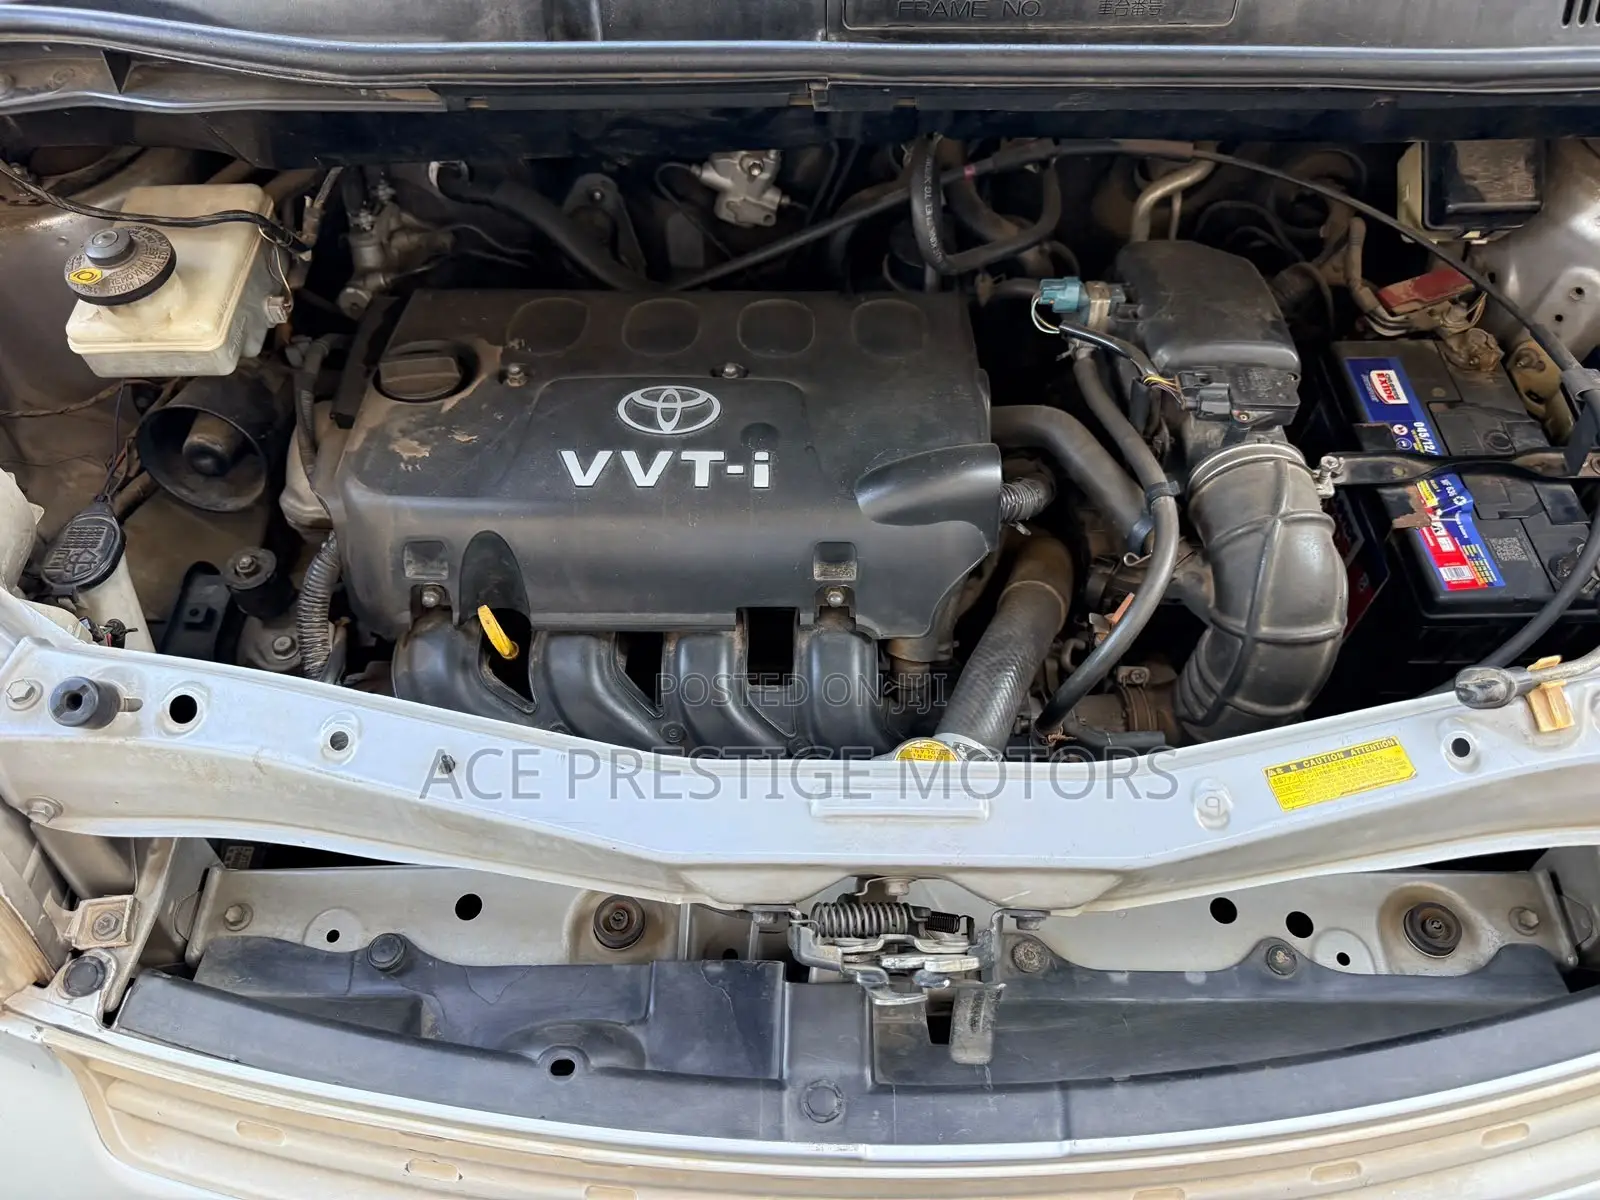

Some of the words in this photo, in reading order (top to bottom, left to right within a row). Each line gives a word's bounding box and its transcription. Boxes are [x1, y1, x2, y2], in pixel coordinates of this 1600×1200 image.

[896, 0, 991, 17] FRAME
[1376, 373, 1396, 400] EXIDE
[1413, 421, 1438, 455] 045/12/
[559, 450, 769, 488] VVT-i
[1303, 750, 1345, 768] CAUTION
[1350, 739, 1395, 757] ATTENTION
